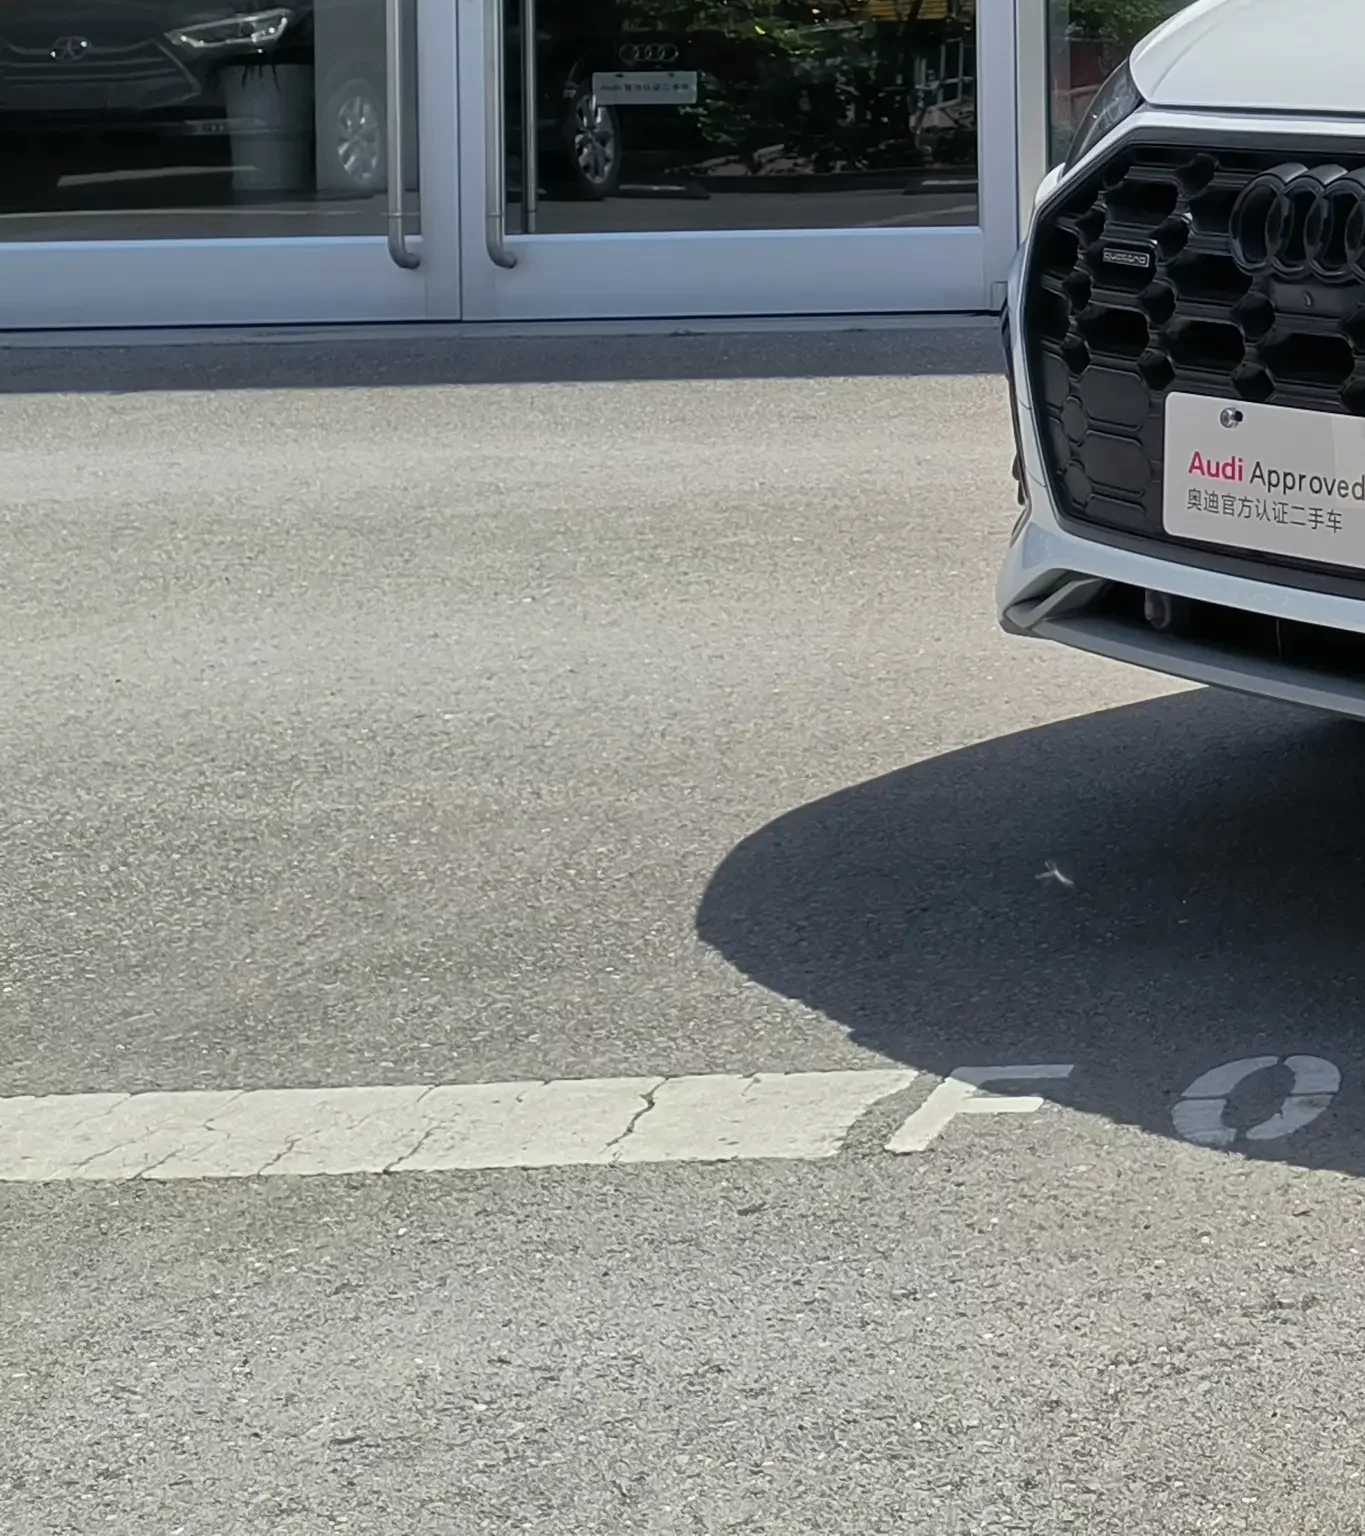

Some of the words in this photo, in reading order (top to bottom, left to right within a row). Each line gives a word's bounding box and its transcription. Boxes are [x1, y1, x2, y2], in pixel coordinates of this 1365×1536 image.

[1103, 251, 1147, 264] quattro
[1188, 450, 1244, 482] Audi
[1186, 487, 1344, 534] 奥迪官方认证二手车
